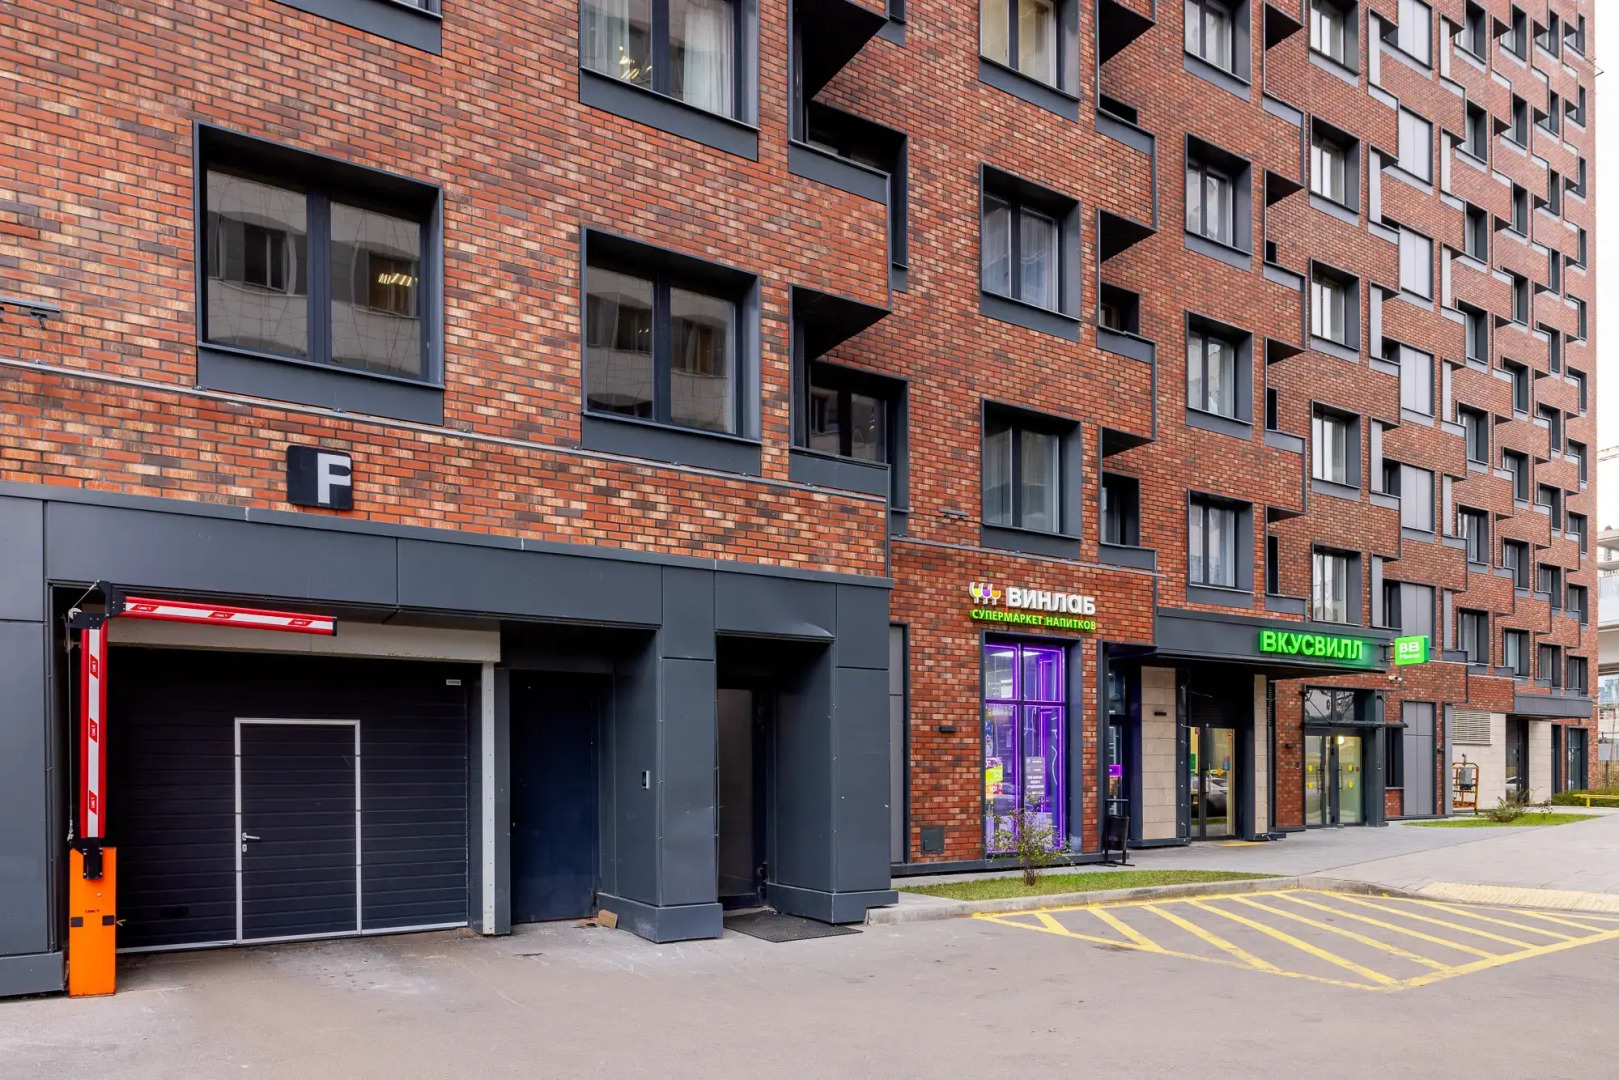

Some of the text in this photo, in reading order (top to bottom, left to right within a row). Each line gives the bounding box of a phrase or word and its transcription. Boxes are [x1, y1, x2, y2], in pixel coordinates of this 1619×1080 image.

[970, 609, 1096, 630] СУПЕРМАРКЕТ НАПИТКОВ
[1260, 630, 1363, 660] ВКУСВИЛЛ
[1399, 641, 1420, 653] ВВ
